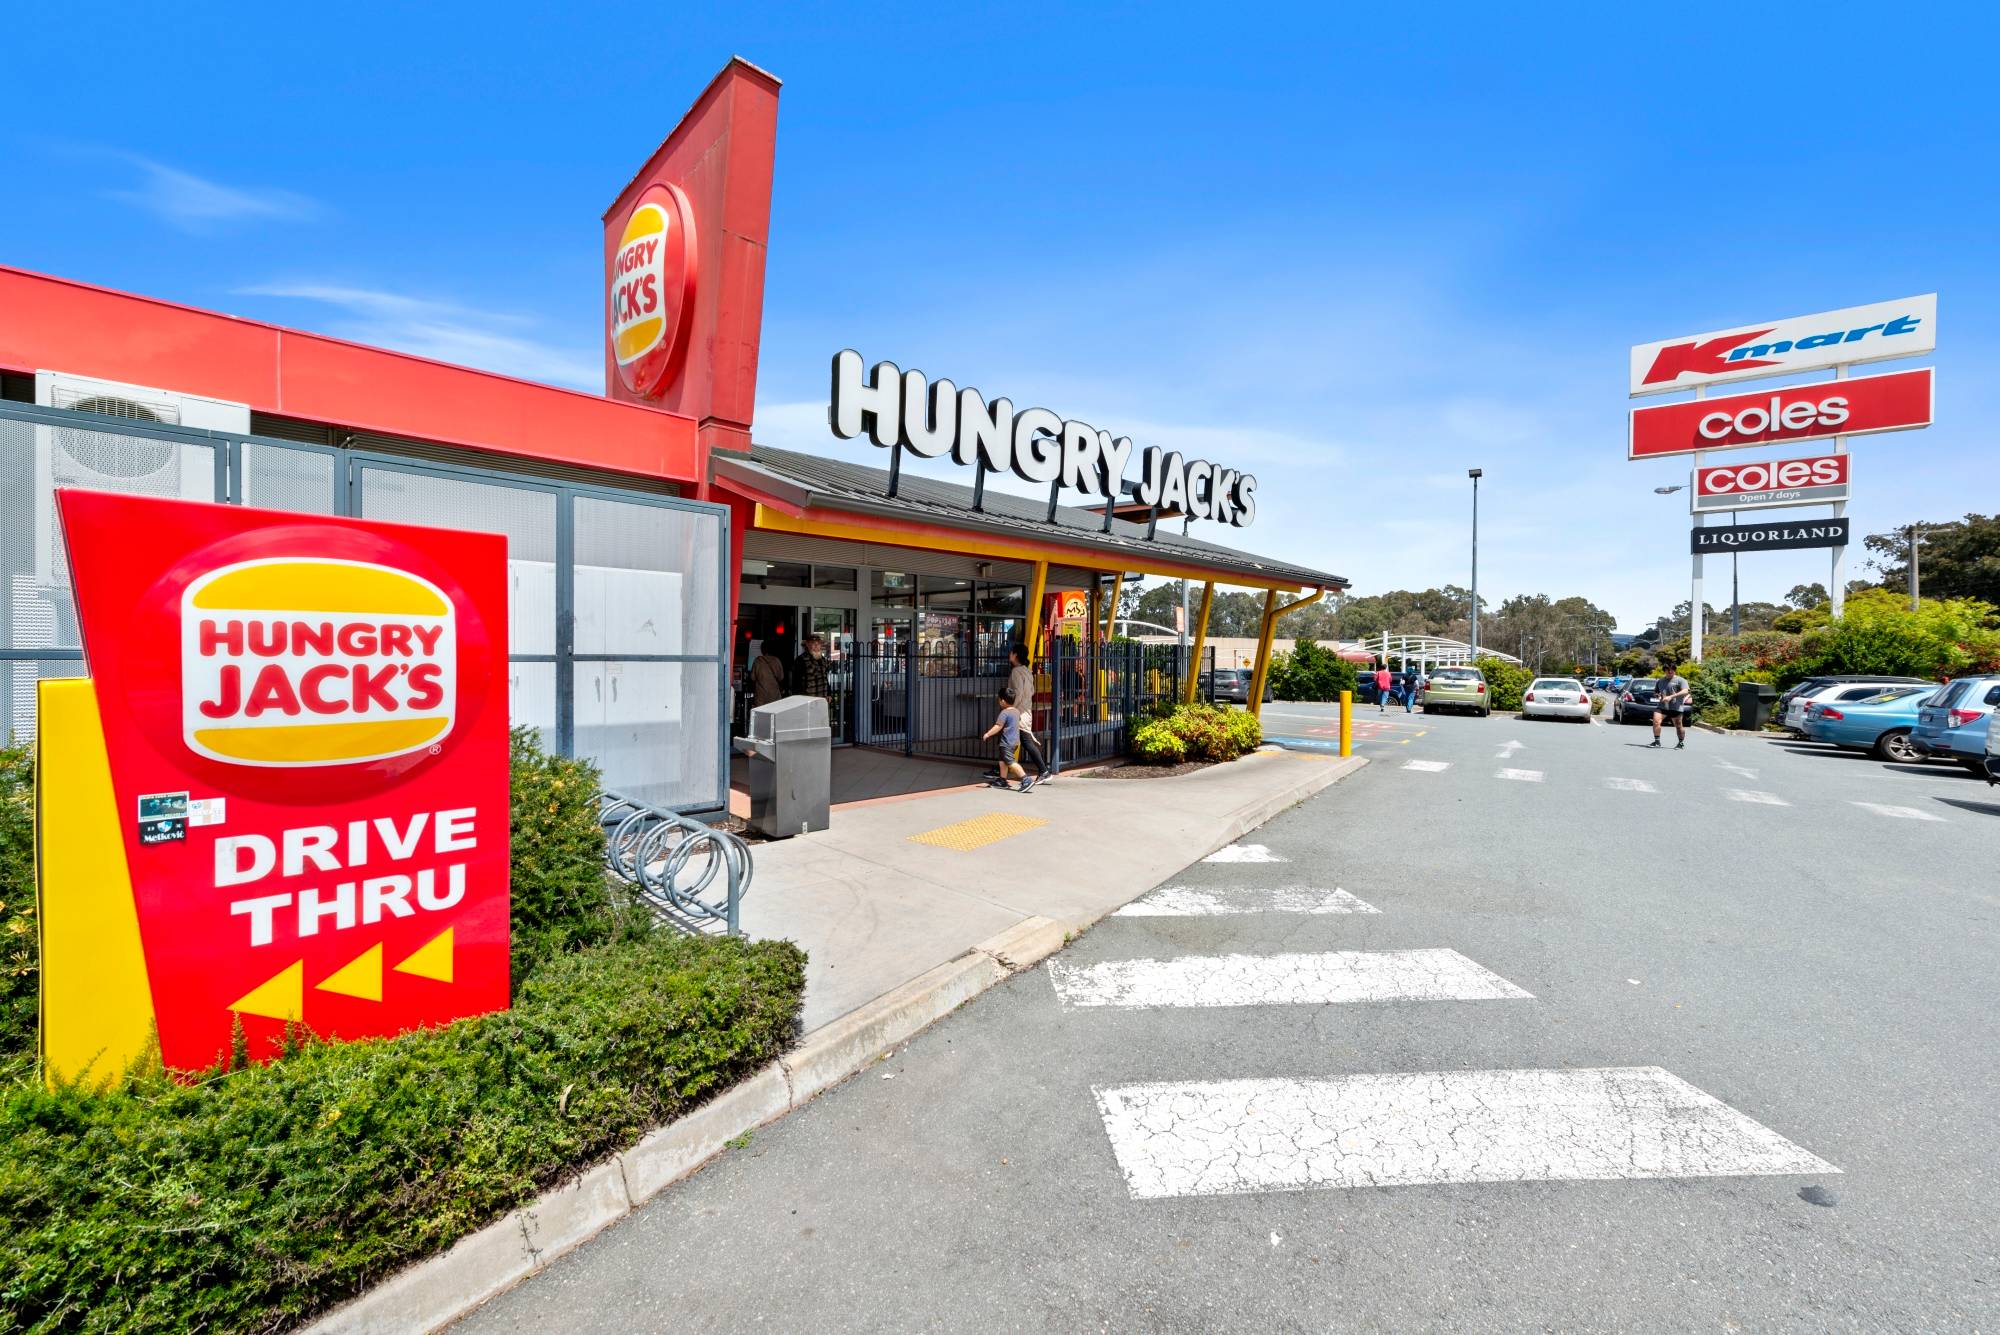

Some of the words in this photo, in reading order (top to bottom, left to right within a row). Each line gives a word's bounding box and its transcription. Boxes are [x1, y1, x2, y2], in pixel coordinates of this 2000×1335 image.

[1641, 314, 1922, 386] Kmart
[831, 348, 1132, 498] HUNGRY
[1133, 445, 1257, 528] JACK'S
[1698, 396, 1850, 439] coles
[1704, 458, 1840, 493] coles
[1739, 493, 1766, 503] Open
[1768, 492, 1775, 500] 7
[1776, 490, 1801, 500] days
[1698, 526, 1843, 546] LIQUORLAND
[199, 619, 443, 657] HUNGRY
[199, 663, 444, 719] JACK'S
[214, 807, 477, 888] DRIVE
[230, 863, 467, 947] THRU
